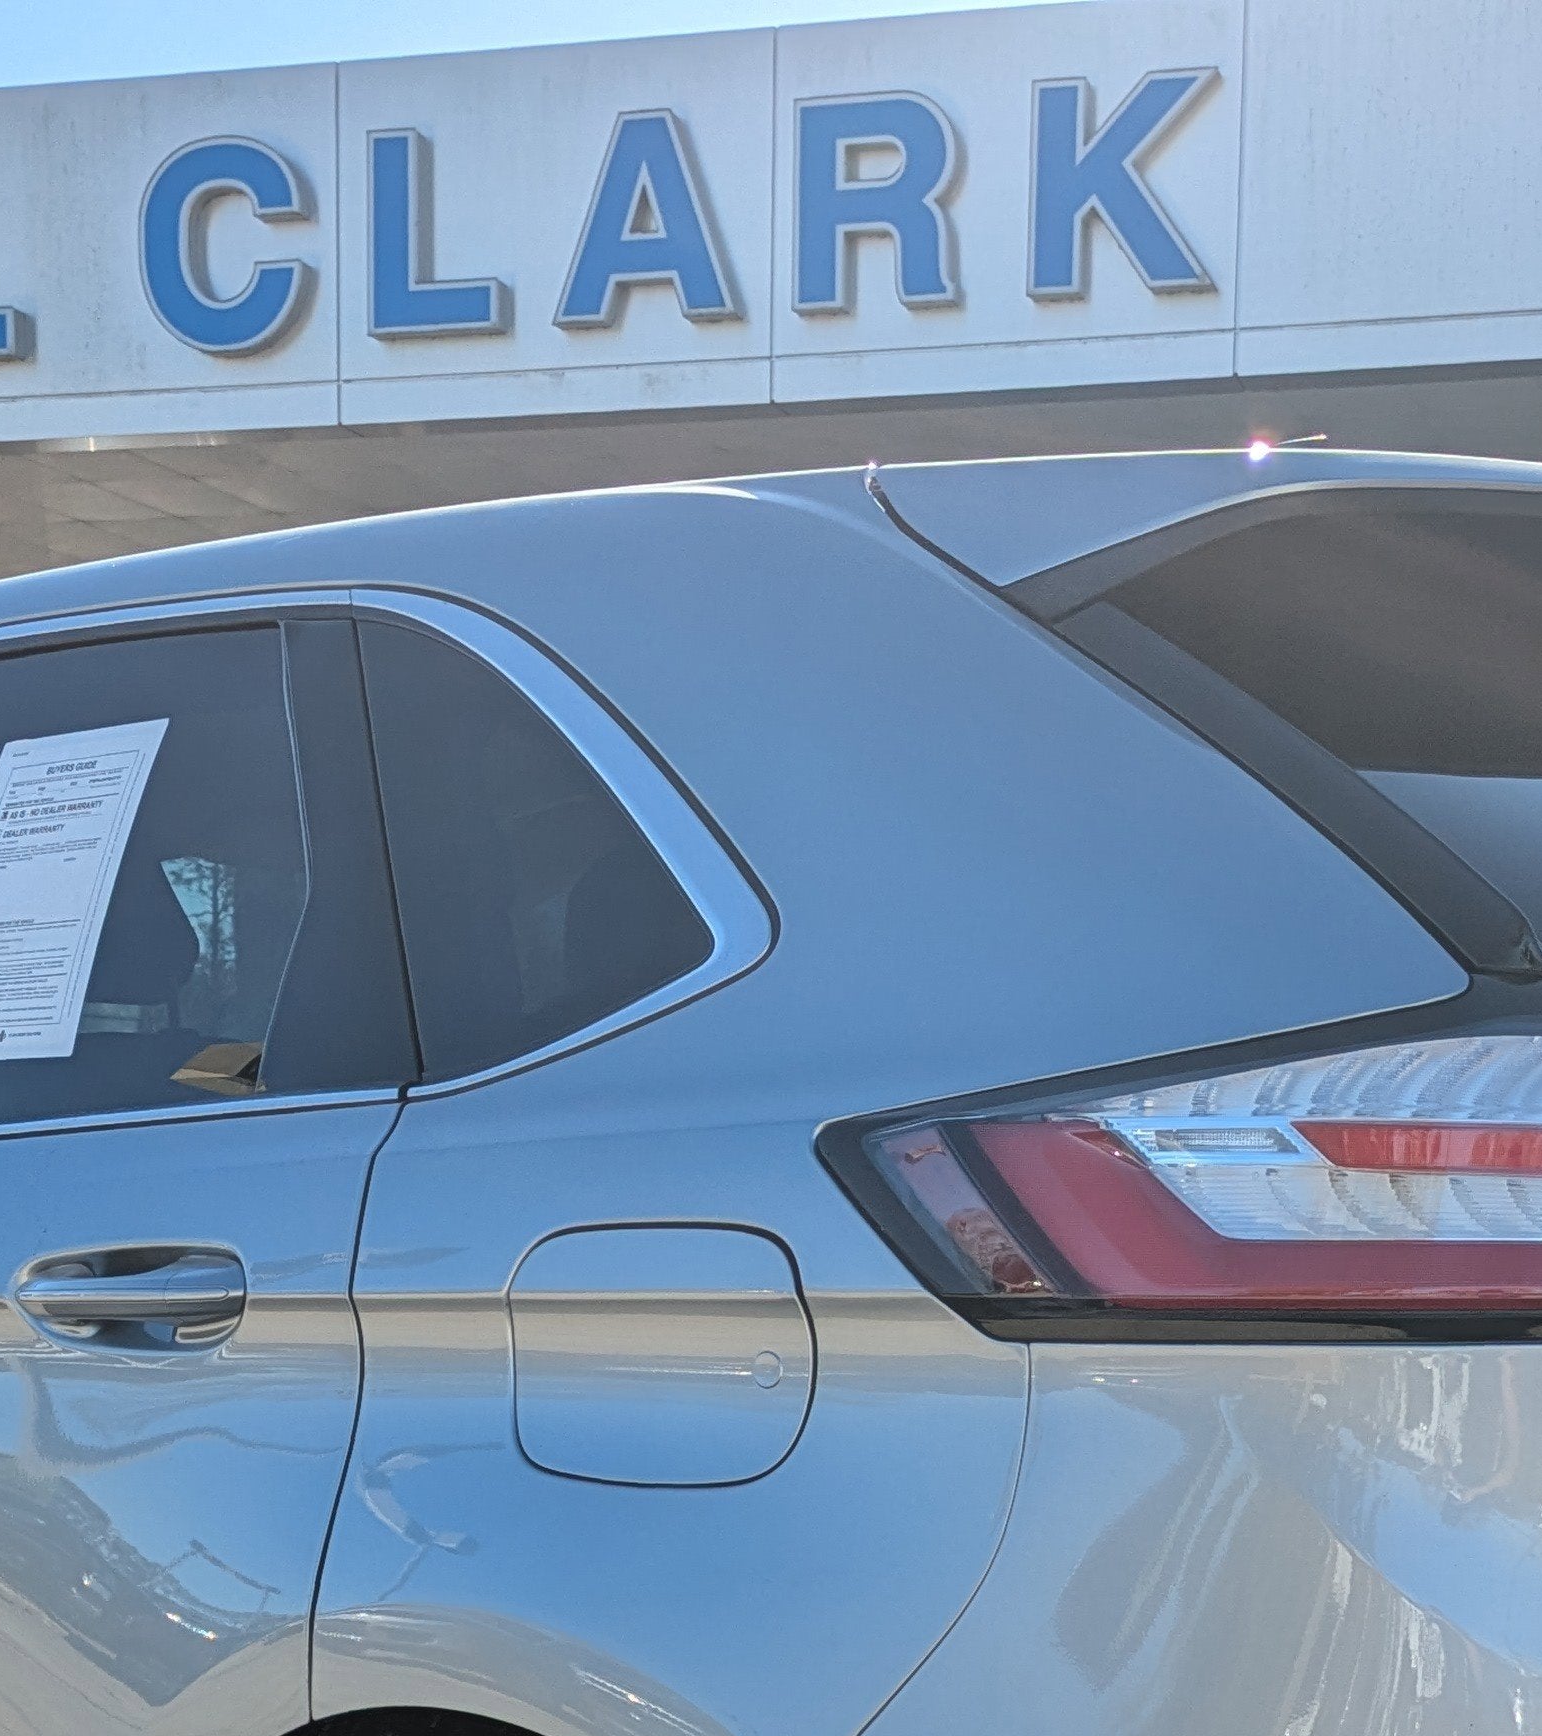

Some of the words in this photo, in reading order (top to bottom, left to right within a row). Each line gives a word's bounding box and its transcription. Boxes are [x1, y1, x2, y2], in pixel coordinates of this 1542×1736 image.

[138, 66, 1222, 358] CLARK
[76, 760, 98, 771] GUIDE
[40, 804, 67, 815] DEALER
[67, 800, 104, 812] WARRANTY
[3, 827, 28, 839] DEALER
[29, 823, 65, 836] WARRANTY
